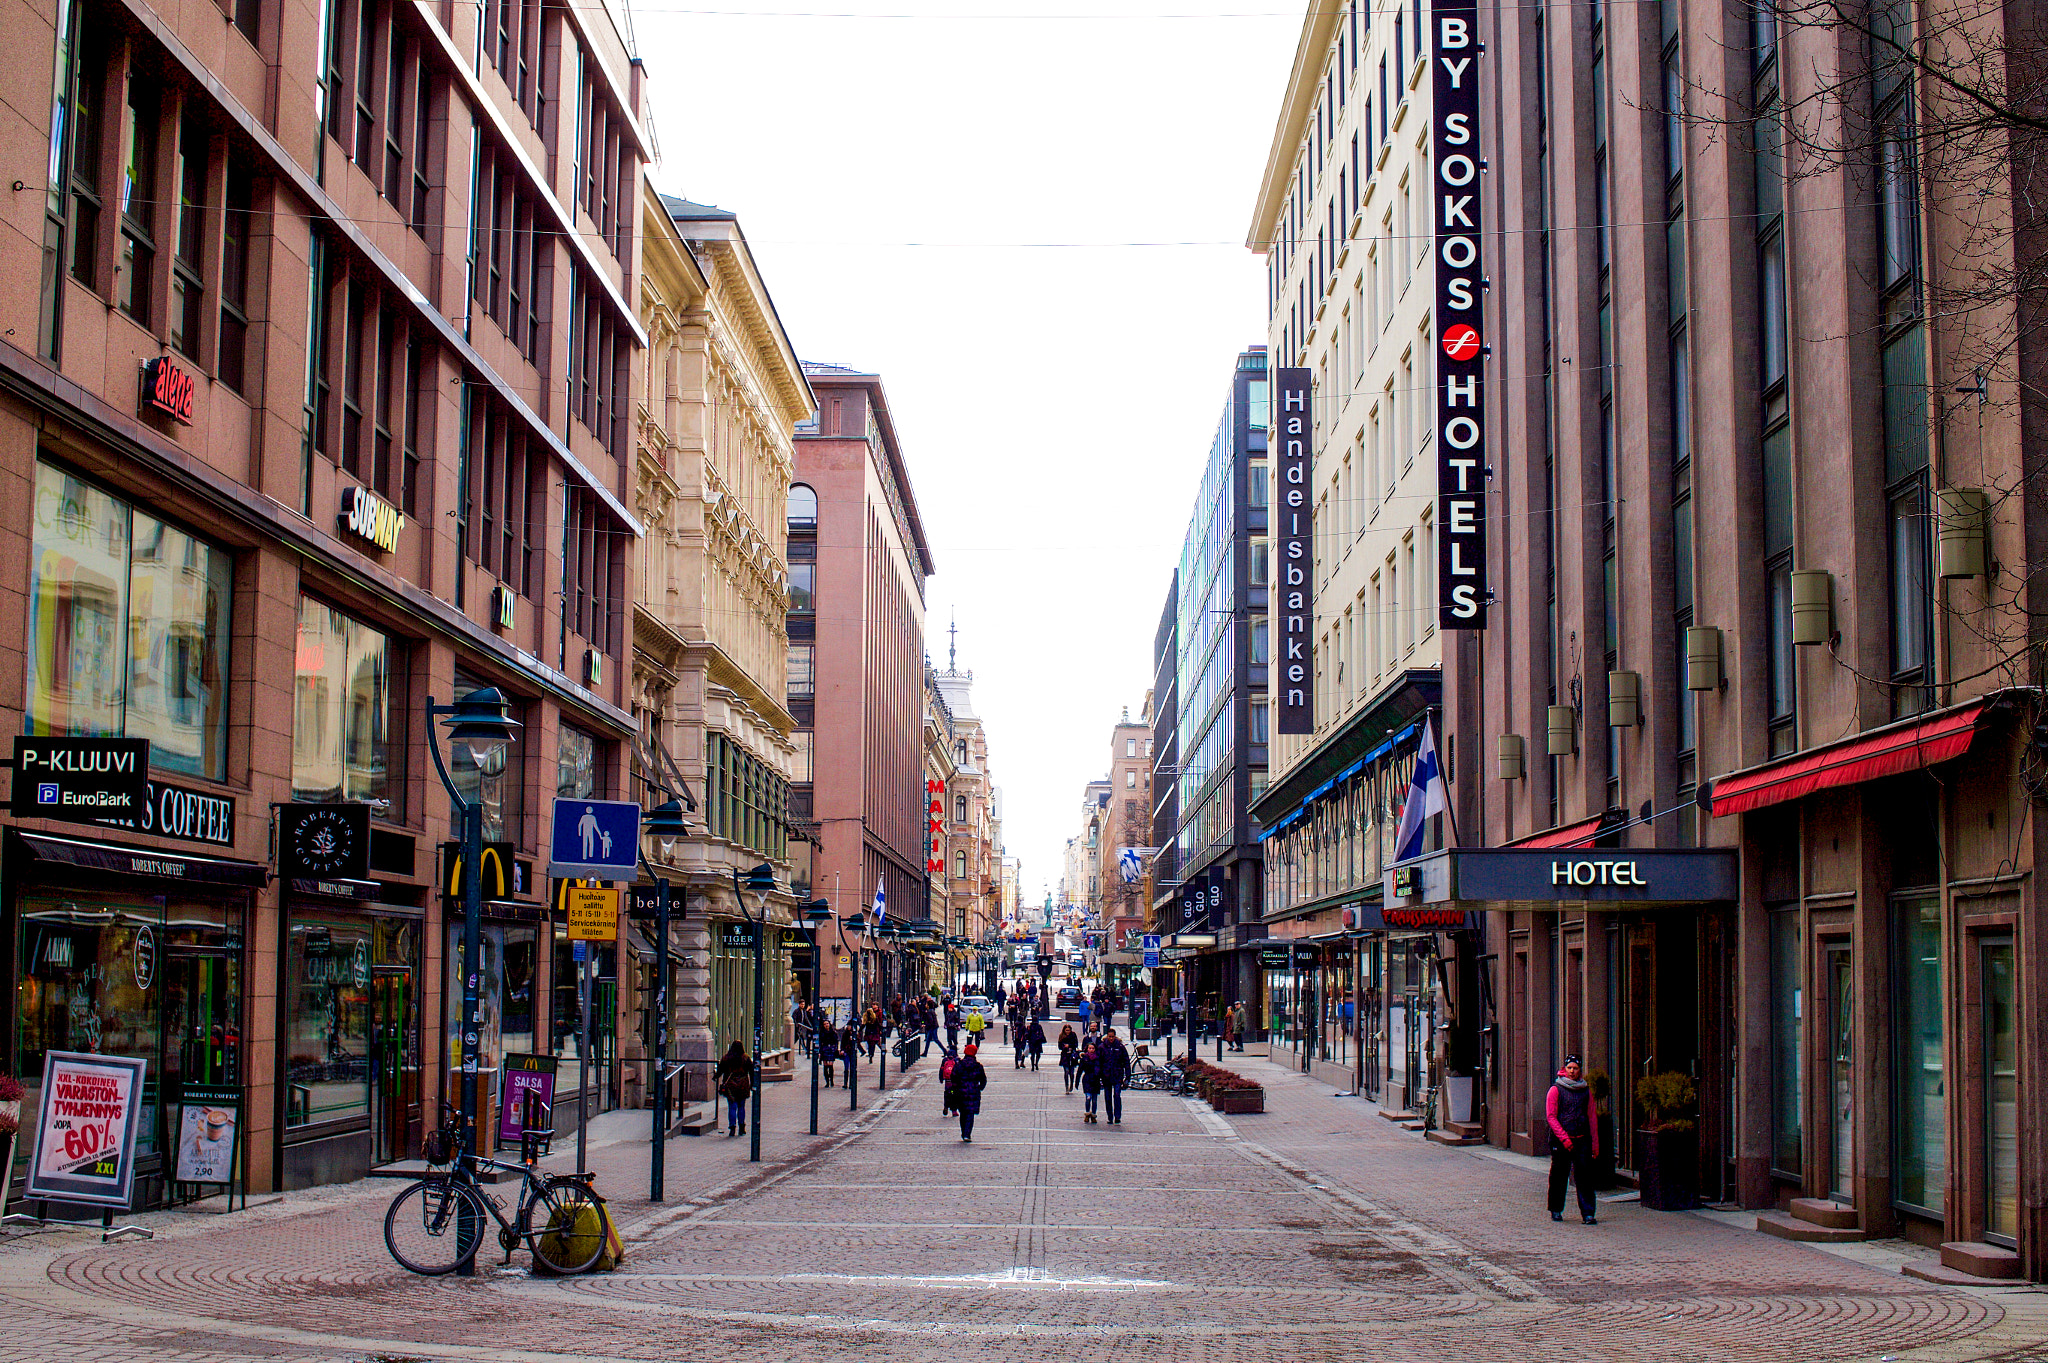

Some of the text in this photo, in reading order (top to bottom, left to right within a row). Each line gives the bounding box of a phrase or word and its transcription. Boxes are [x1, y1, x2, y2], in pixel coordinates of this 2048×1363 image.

[1440, 17, 1479, 619] BY SOKOS HOTELS
[348, 485, 405, 555] SUBWAY
[1284, 388, 1304, 707] Handelsbanken
[500, 586, 515, 630] XXL
[591, 649, 602, 685] XXL
[22, 749, 135, 773] P-KLUUVI
[62, 790, 131, 806] EuroPark
[160, 787, 231, 843] COFFEE
[927, 779, 945, 873] MAXIM
[131, 857, 185, 877] ROBERT'S COFFEE
[295, 847, 351, 872] COFFEE
[1551, 861, 1647, 886] HOTEL
[578, 893, 606, 901] Huoltoajo
[583, 902, 604, 910] sallittu
[636, 895, 681, 912] bele
[1195, 891, 1205, 912] GLO
[1210, 885, 1220, 907] GLO
[571, 909, 583, 917] 5-11
[1184, 900, 1193, 918] GLO
[569, 919, 616, 928] Servicekörning
[722, 935, 753, 943] TIGER
[57, 1073, 118, 1088] XXL-KOKOINEN
[514, 1075, 543, 1089] SALSA
[56, 1083, 124, 1103] VARASTON-
[53, 1100, 122, 1120] TYHJENNYS
[53, 1119, 72, 1130] JOPA
[55, 1118, 116, 1160] -60%
[95, 1161, 115, 1175] XXL
[194, 1167, 213, 1177] 2,90
